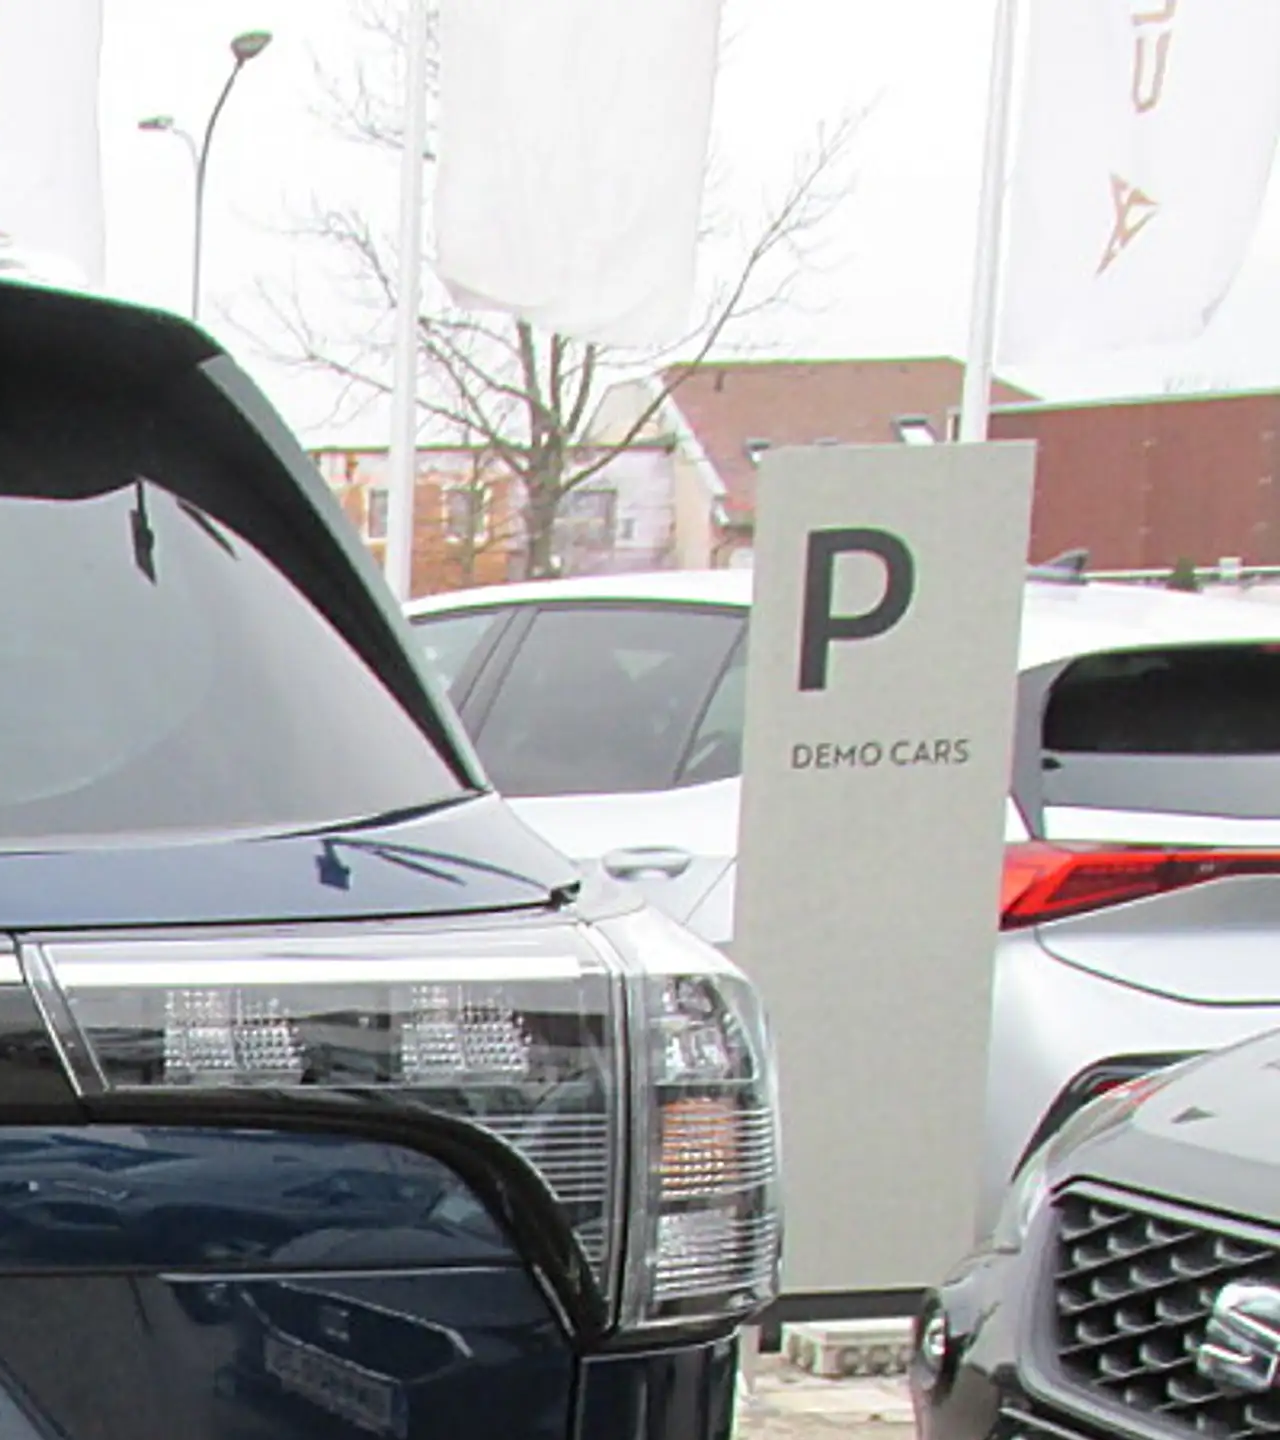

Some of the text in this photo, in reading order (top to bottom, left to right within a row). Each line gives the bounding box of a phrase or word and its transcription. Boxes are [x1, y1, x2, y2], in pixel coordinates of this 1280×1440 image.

[798, 528, 915, 692] P
[791, 738, 970, 769] DEMO CARS
